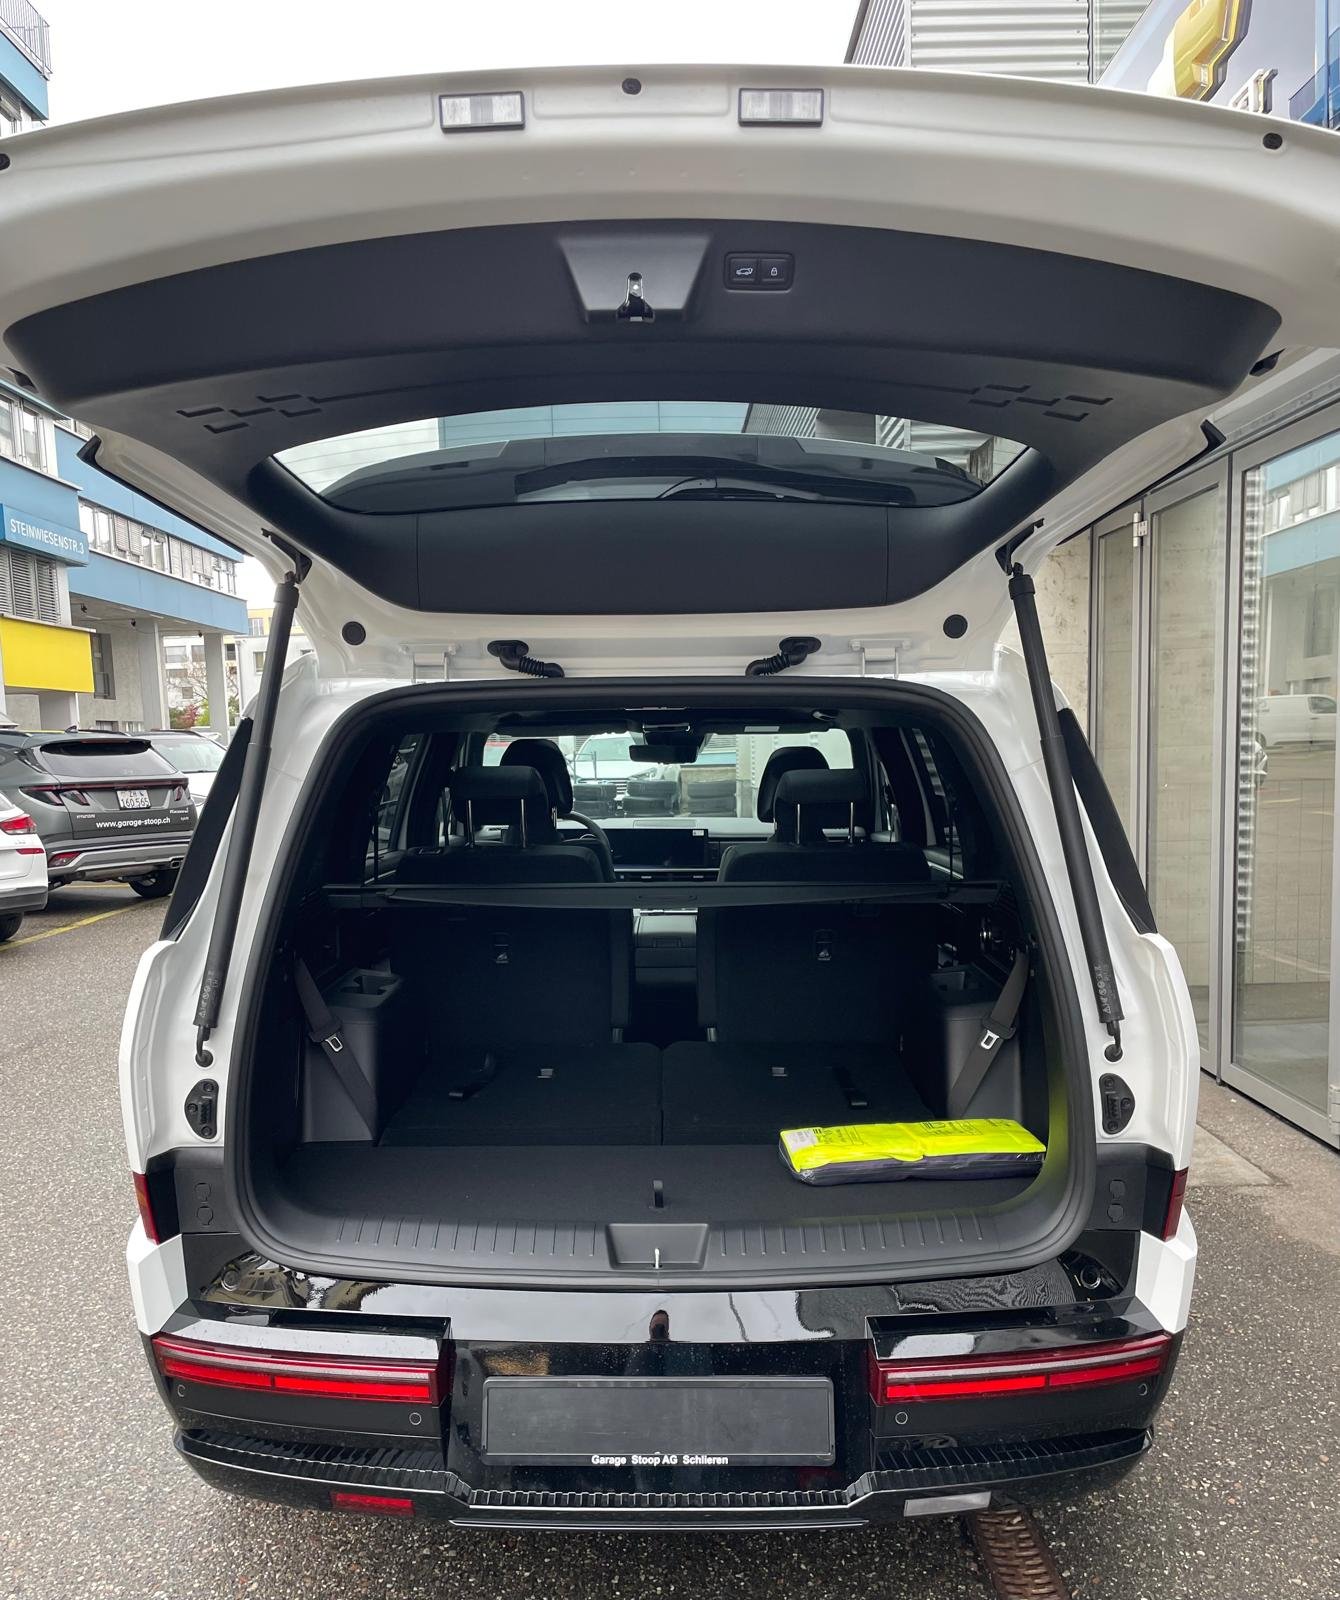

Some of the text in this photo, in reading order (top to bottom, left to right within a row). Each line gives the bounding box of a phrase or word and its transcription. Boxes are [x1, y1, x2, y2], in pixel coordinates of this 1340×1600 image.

[96, 817, 171, 828] www.garage-stoop.ch
[591, 1455, 729, 1466] Garage Stoop AG Schlieren
